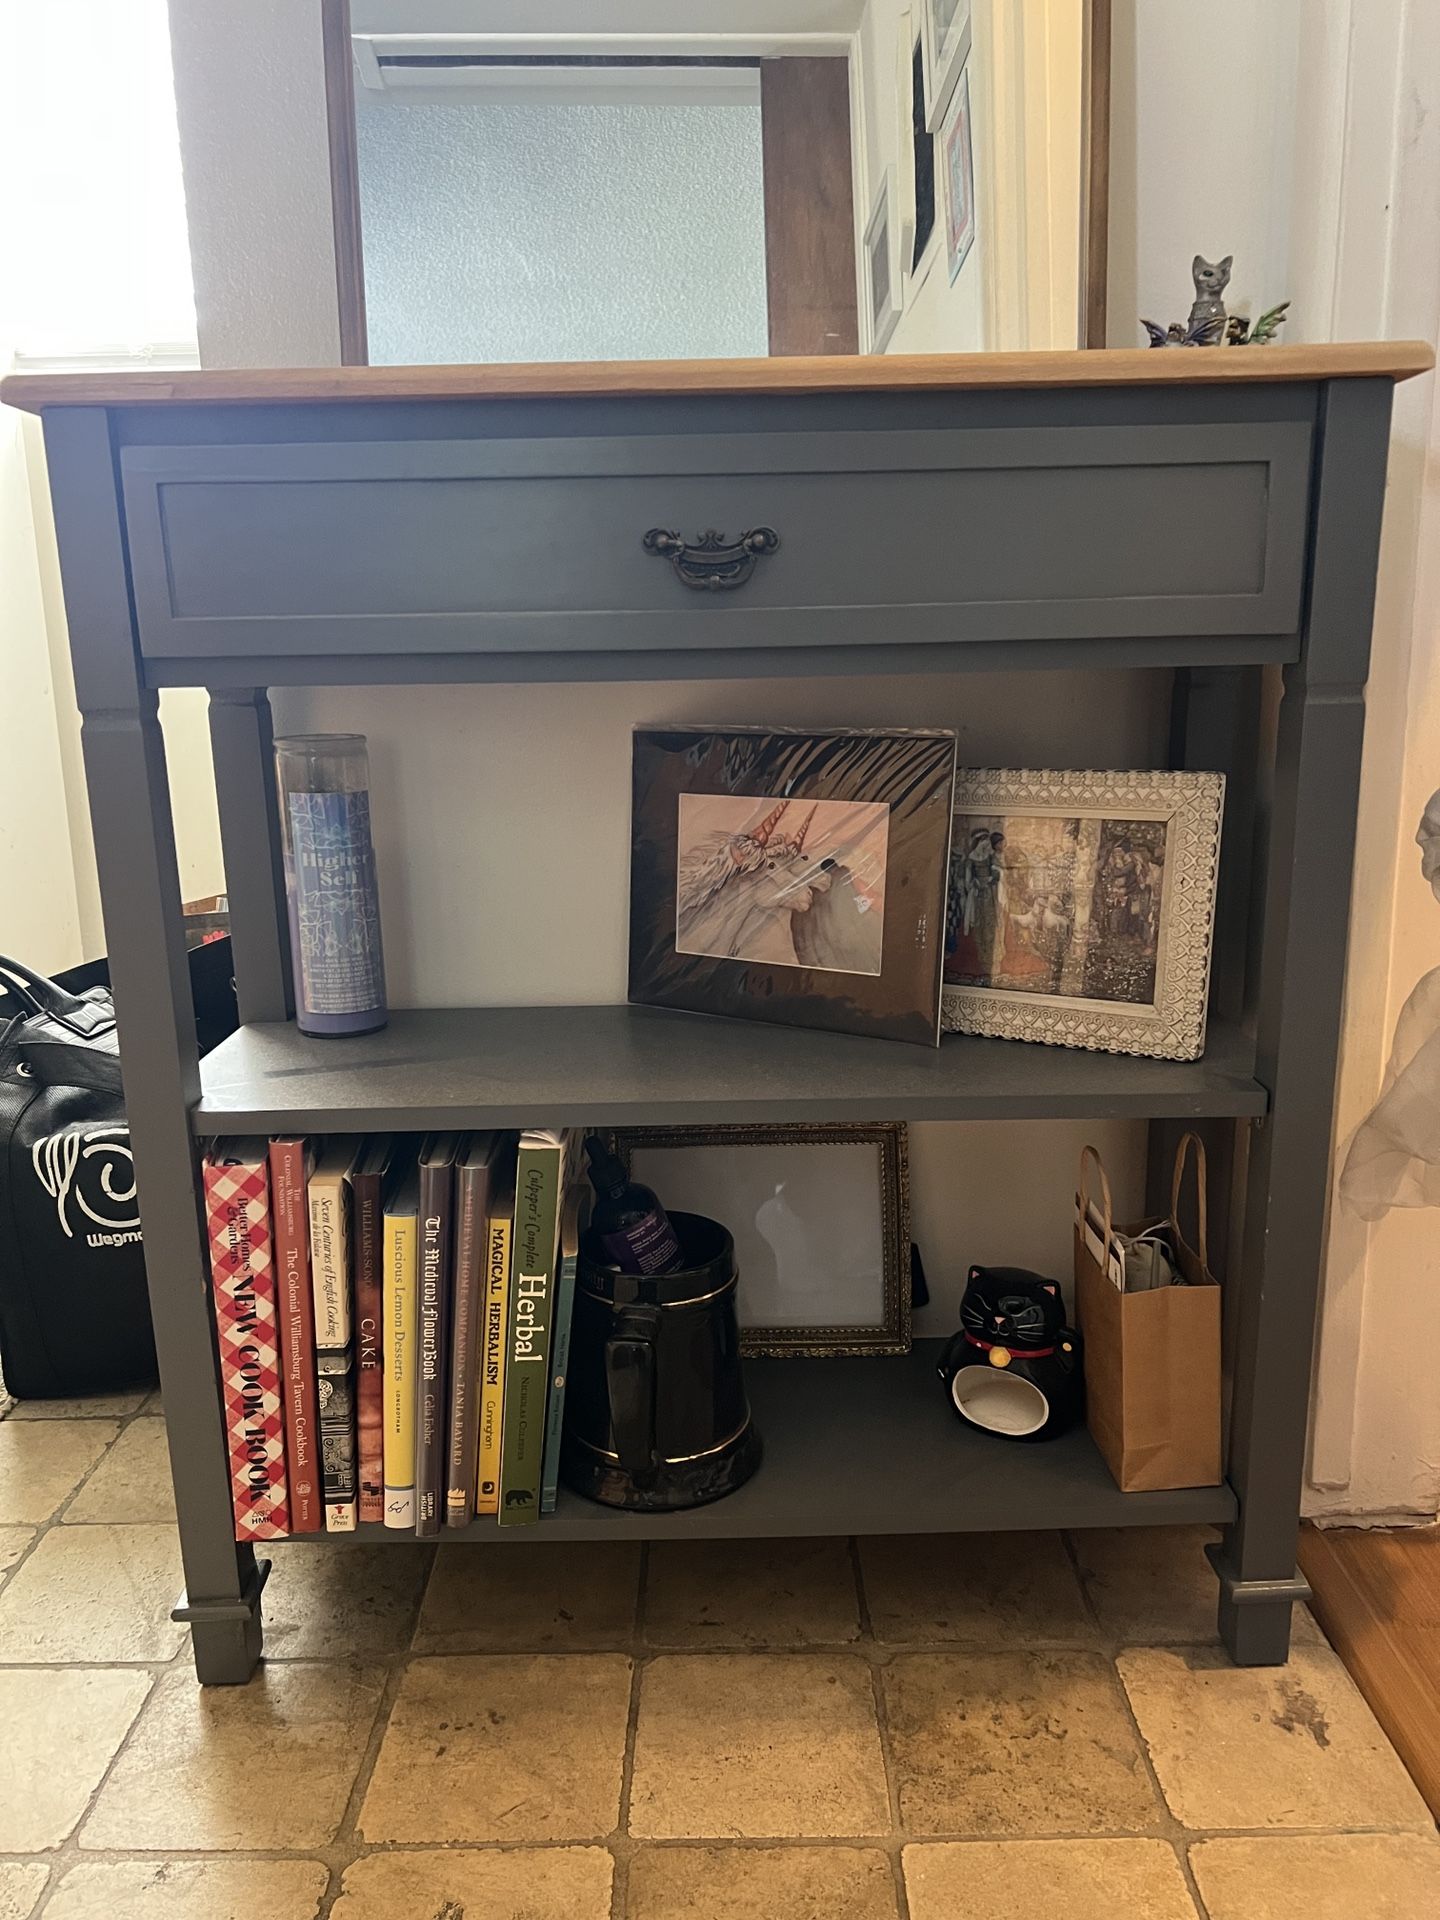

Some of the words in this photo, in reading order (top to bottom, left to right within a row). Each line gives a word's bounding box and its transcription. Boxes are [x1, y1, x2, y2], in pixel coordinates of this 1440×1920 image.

[302, 852, 369, 871] Higher
[319, 870, 360, 886] Self
[238, 1198, 249, 1231] Better
[321, 1197, 333, 1223] Seven
[425, 1216, 441, 1243] The
[228, 1218, 240, 1264] Gardens
[240, 1233, 251, 1271] Homes
[287, 1248, 298, 1269] The
[323, 1225, 335, 1265] Centuries
[394, 1230, 406, 1284] Luscious
[490, 1228, 504, 1295] MAGICAL
[522, 1223, 541, 1269] Complete
[288, 1272, 300, 1313] Colonial
[323, 1275, 337, 1305] English
[424, 1248, 440, 1306] Medieval
[232, 1275, 258, 1337] NEW
[326, 1306, 339, 1337] Cooking
[394, 1287, 406, 1328] Lemon
[515, 1272, 547, 1362] Herbal
[291, 1315, 303, 1380] Williamsburg
[361, 1318, 376, 1369] CAKE
[457, 1299, 468, 1371] COMPANION
[486, 1302, 501, 1385] HERBALISM
[394, 1331, 406, 1382] Desserts
[423, 1350, 437, 1380] Book
[239, 1345, 265, 1420] COOK
[294, 1382, 304, 1414] Tavern
[455, 1382, 465, 1418] TANIA
[424, 1394, 435, 1417] Celia
[483, 1401, 496, 1450] Cunningham
[295, 1417, 308, 1467] Cookbook
[424, 1419, 435, 1446] Fisher
[454, 1422, 464, 1466] BAYARD
[245, 1428, 271, 1501] BOOK
[251, 1516, 272, 1525] HMH
